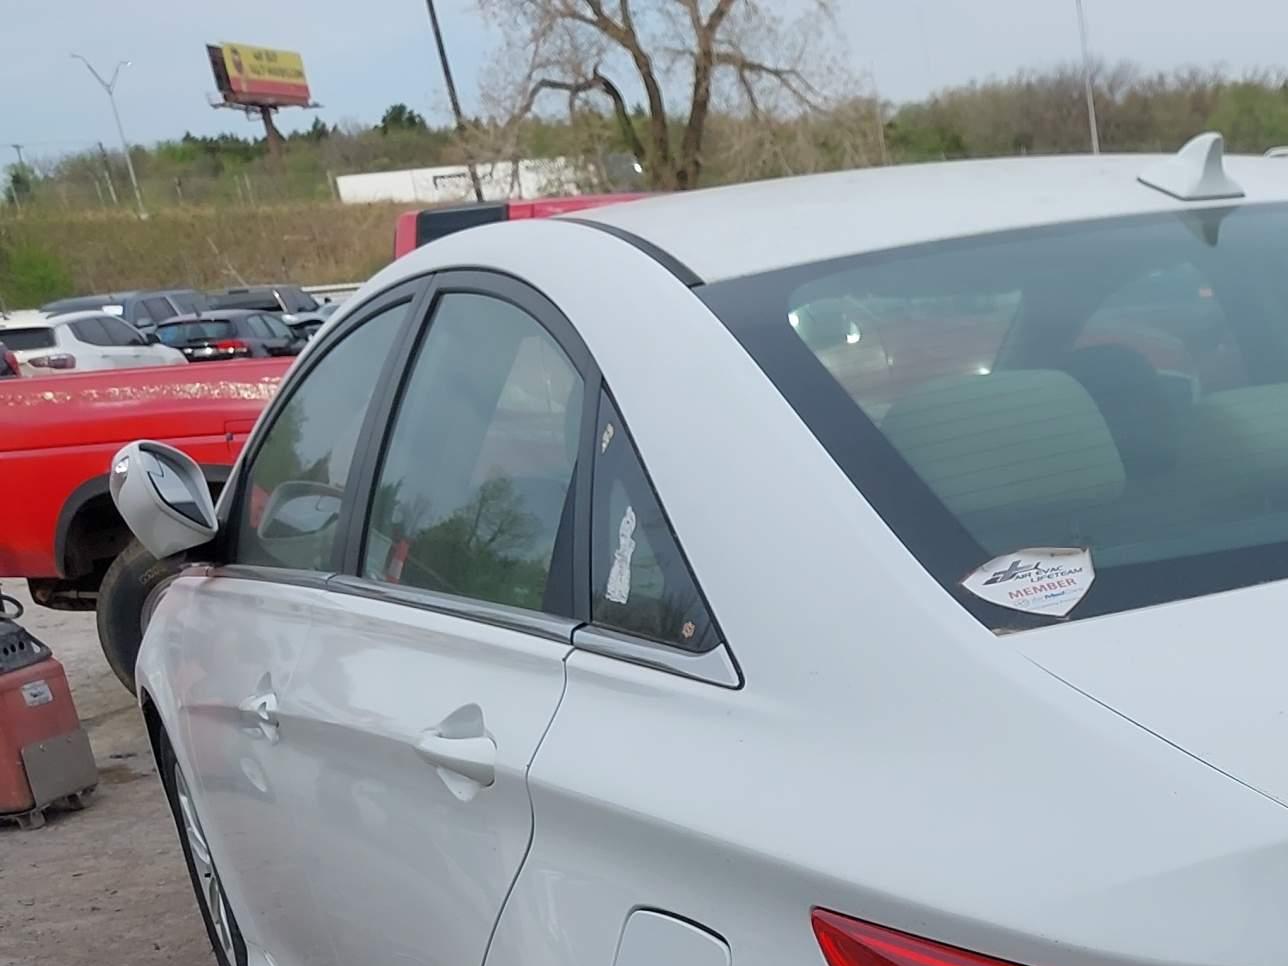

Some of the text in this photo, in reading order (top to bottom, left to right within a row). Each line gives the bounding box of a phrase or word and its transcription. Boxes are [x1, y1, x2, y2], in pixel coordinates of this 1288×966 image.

[1014, 571, 1033, 581] AIR
[1030, 567, 1083, 583] LIFETEAM
[1008, 578, 1078, 600] MEMBER
